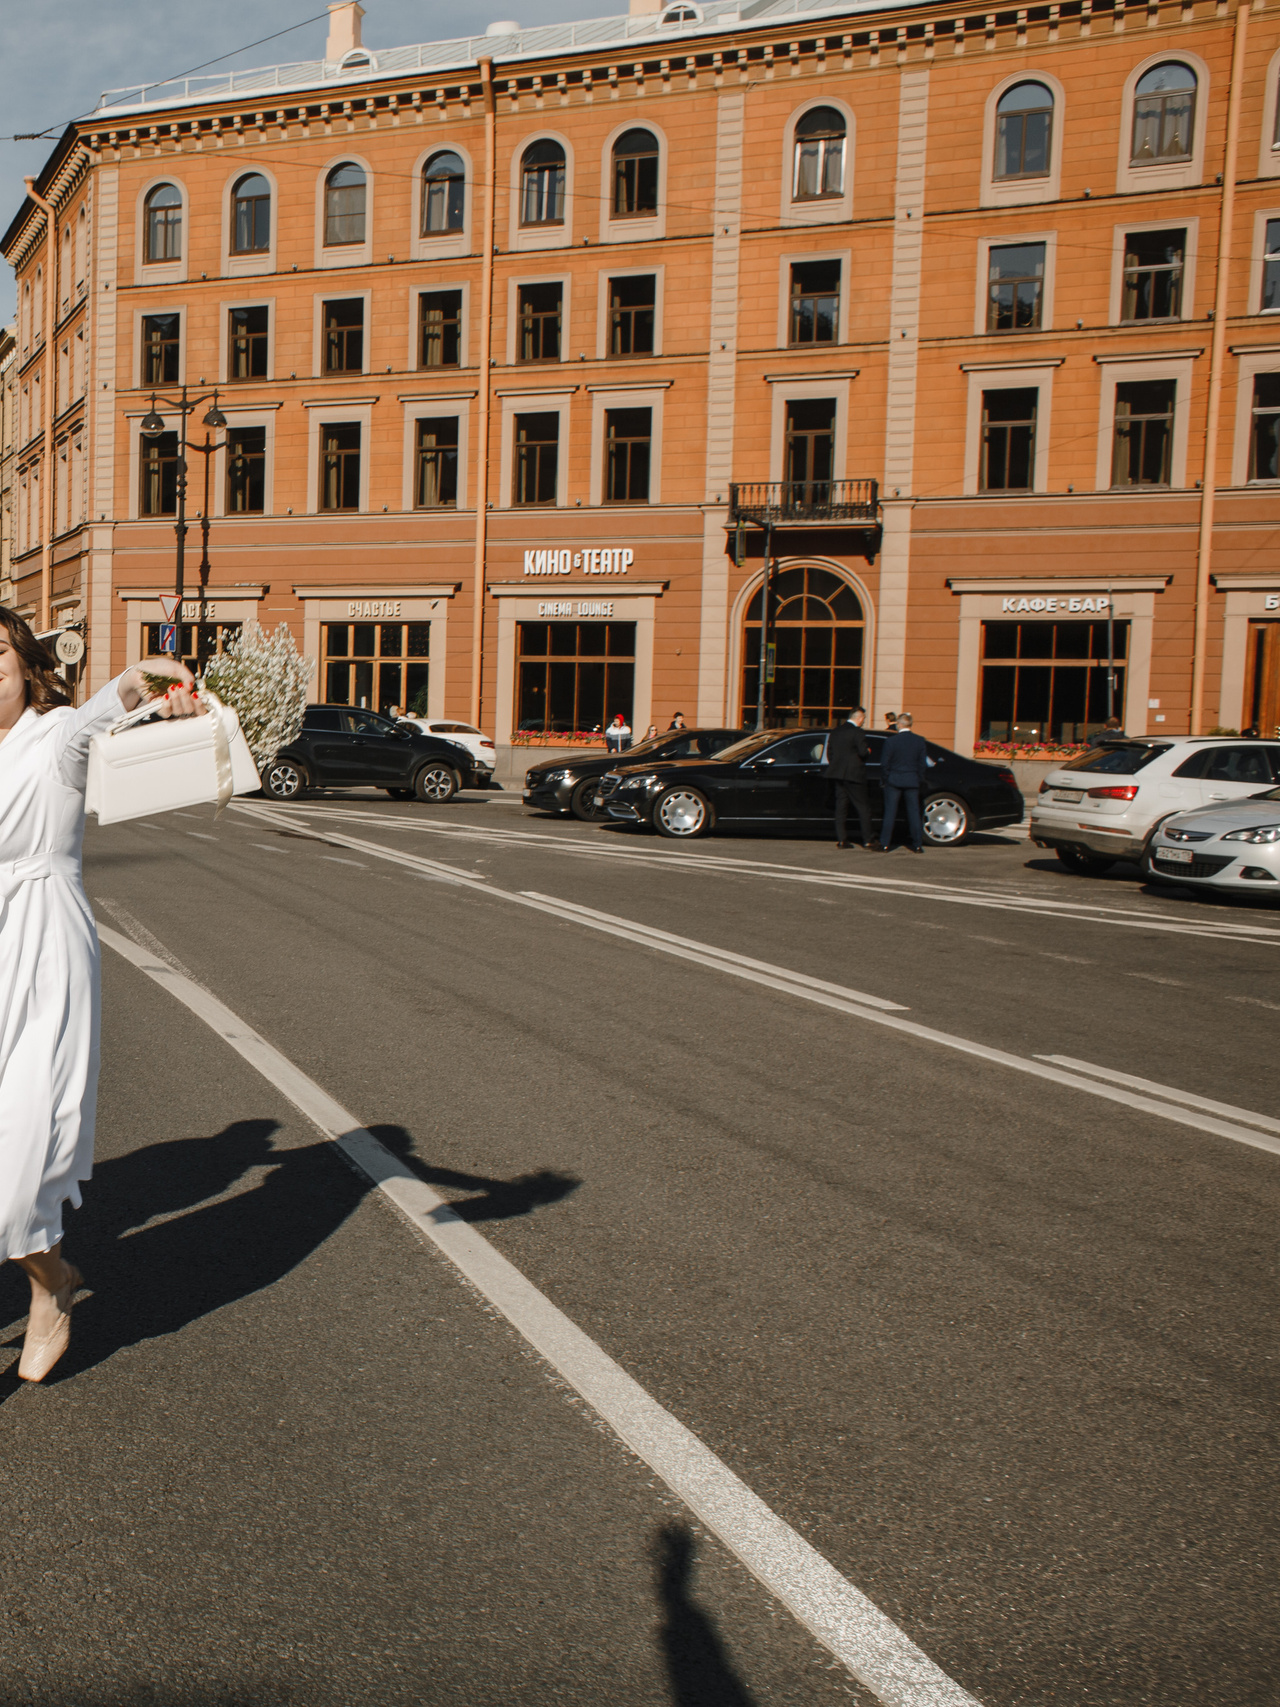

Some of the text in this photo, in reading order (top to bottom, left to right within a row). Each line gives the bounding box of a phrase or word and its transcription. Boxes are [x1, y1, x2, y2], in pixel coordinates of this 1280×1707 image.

[181, 603, 216, 617] АСТЬЕ
[348, 601, 401, 617] СЧАСТЬЕ
[538, 602, 614, 616] CINEMA LOUNGE
